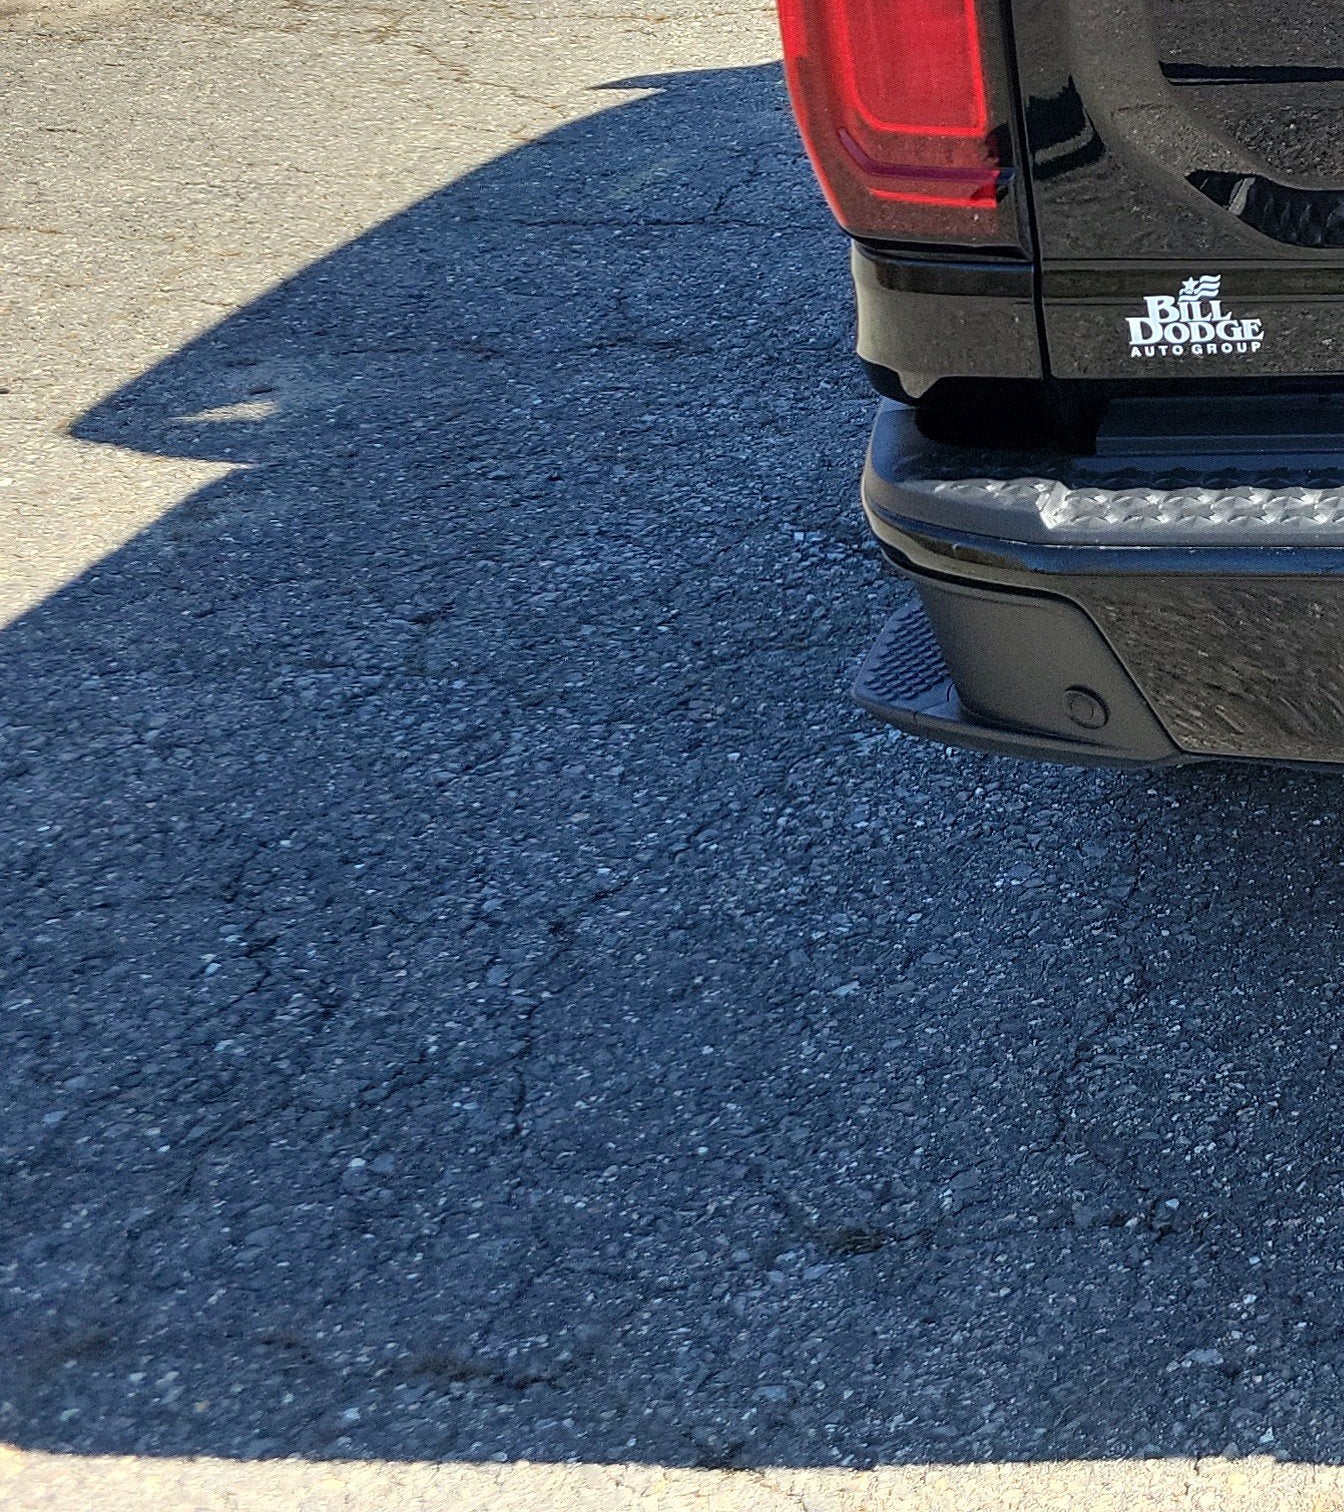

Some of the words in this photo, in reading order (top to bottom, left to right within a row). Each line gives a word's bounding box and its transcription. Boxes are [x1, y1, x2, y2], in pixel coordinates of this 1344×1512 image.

[1143, 295, 1232, 323] BILL
[1125, 317, 1265, 345] DODGE
[1130, 344, 1183, 358] AUTO
[1191, 341, 1262, 355] GROUP
